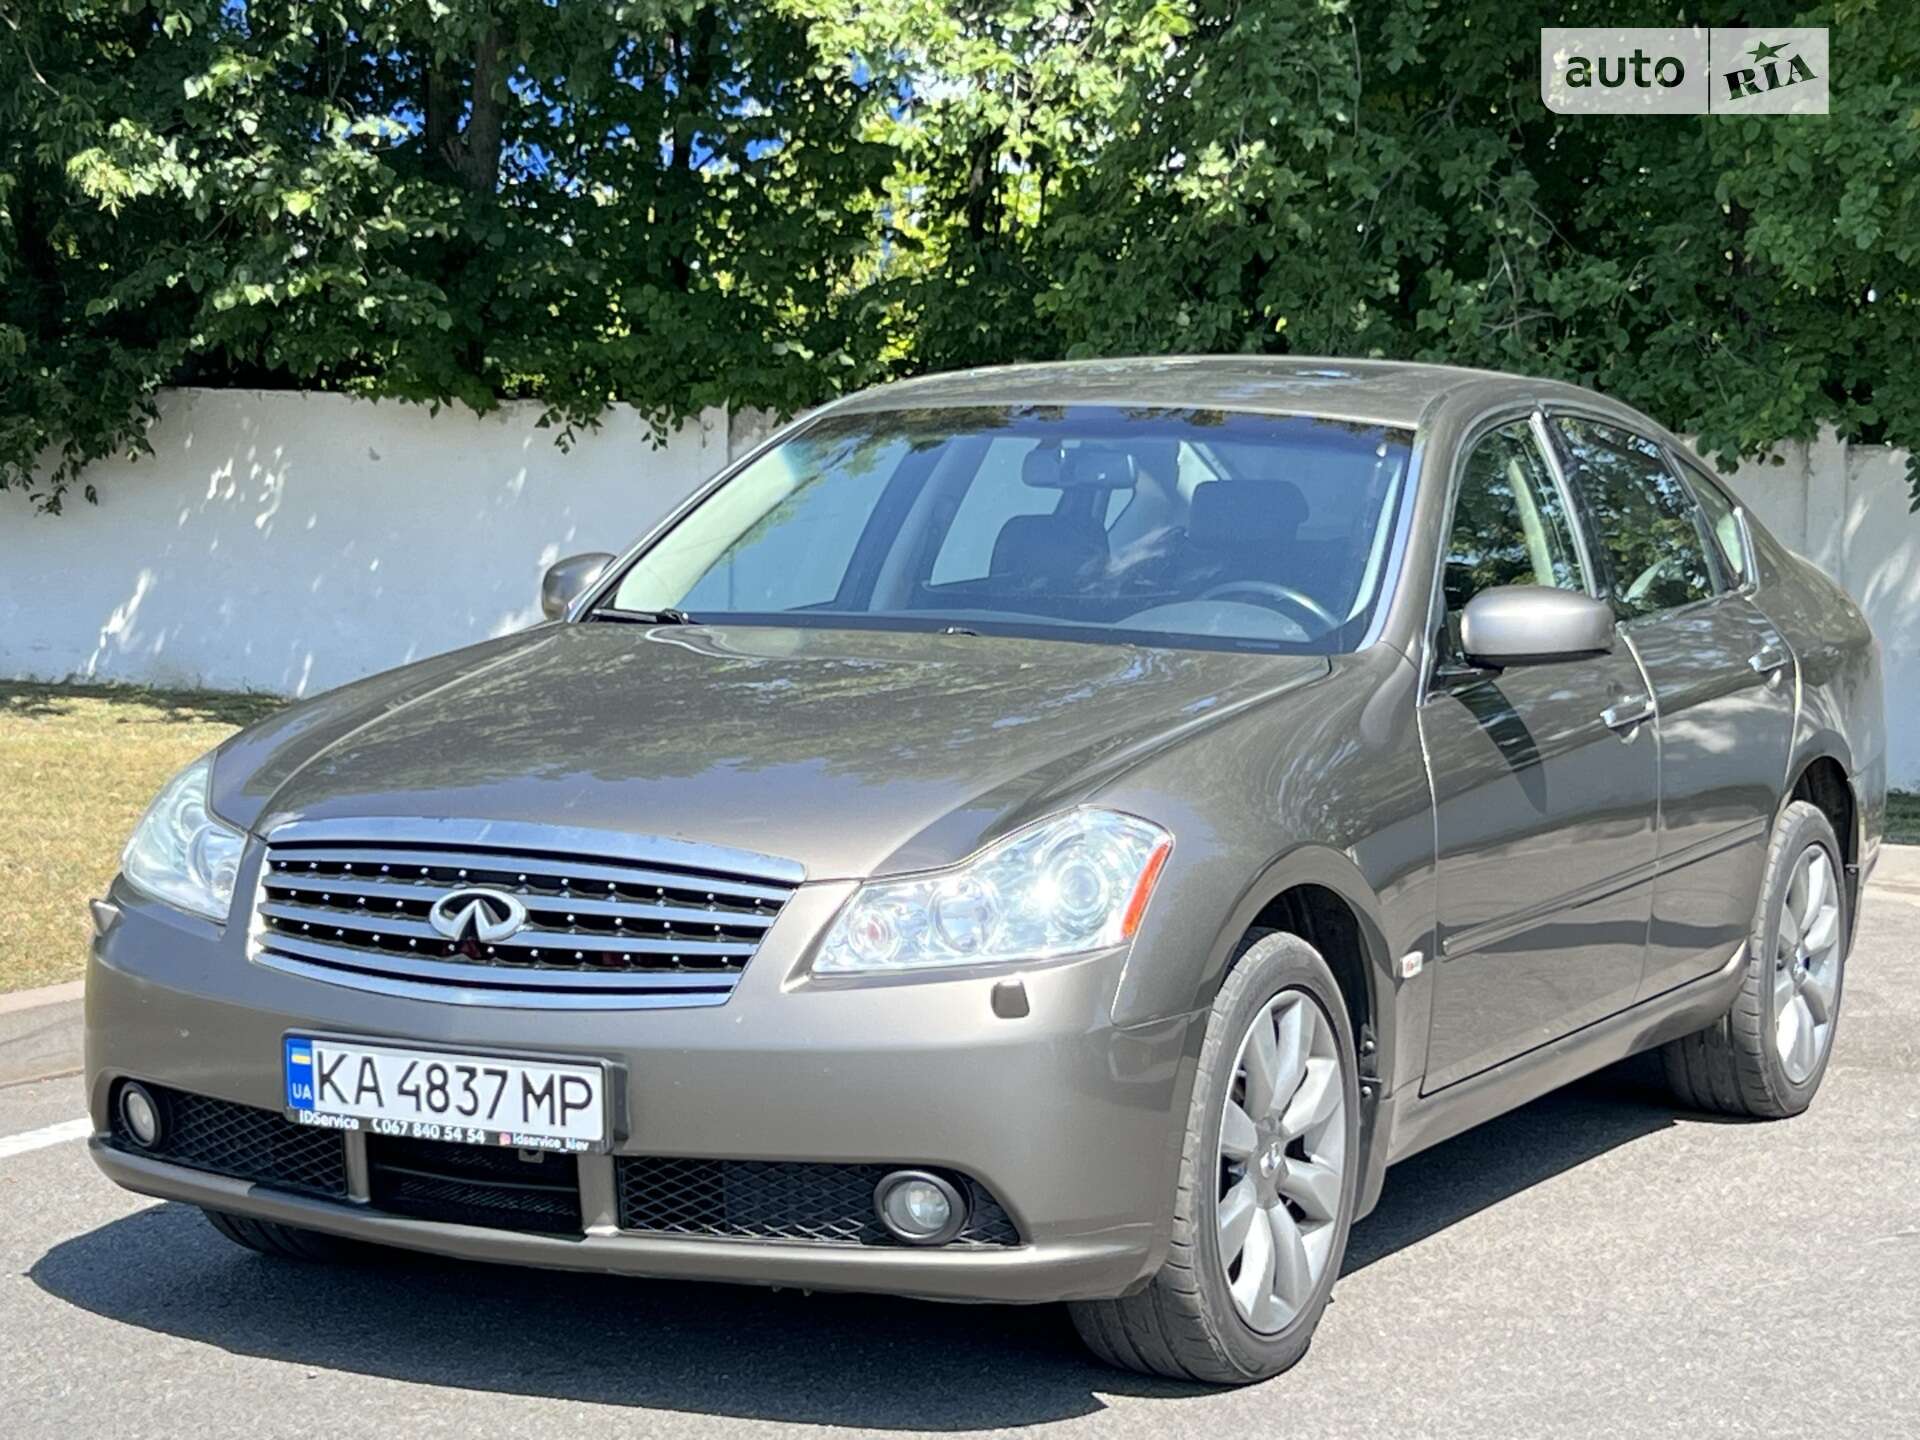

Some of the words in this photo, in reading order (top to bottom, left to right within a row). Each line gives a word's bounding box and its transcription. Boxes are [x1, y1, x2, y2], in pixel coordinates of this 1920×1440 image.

[292, 1083, 312, 1100] UA
[317, 1051, 384, 1107] KA
[397, 1060, 508, 1120] 4837
[521, 1070, 593, 1126] MP
[299, 1109, 359, 1130] IDService
[382, 1119, 409, 1136] 067
[413, 1123, 440, 1140] 840
[444, 1126, 463, 1140] 54
[466, 1128, 485, 1144] 54
